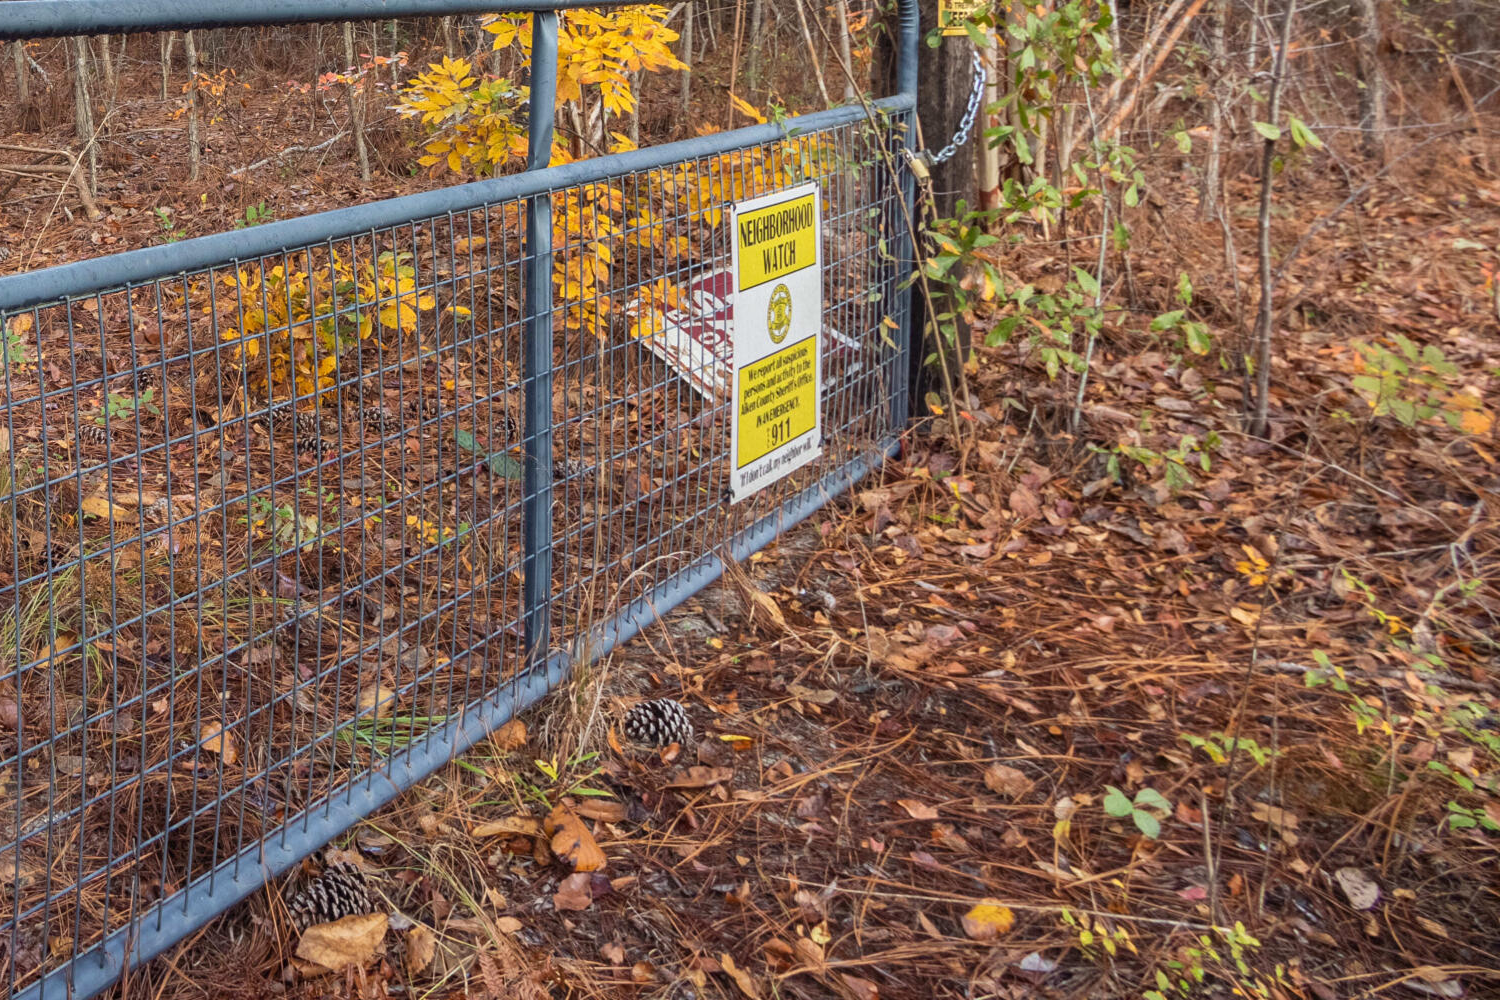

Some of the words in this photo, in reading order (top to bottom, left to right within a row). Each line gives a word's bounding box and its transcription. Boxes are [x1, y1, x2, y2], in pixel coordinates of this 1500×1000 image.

[740, 203, 813, 249] NEIGHBORHOOD
[763, 240, 796, 274] WATCH
[748, 369, 757, 381] We
[757, 360, 775, 378] report
[783, 348, 808, 365] suspicious
[743, 383, 766, 402] persons
[766, 374, 776, 388] and
[777, 366, 796, 383] activity
[797, 363, 802, 374] to
[803, 360, 811, 371] the
[741, 401, 756, 415] Aiken
[756, 391, 775, 408] County
[756, 415, 762, 428] IN
[772, 417, 790, 446] 911
[773, 458, 780, 471] my
[781, 446, 802, 465] neighbor
